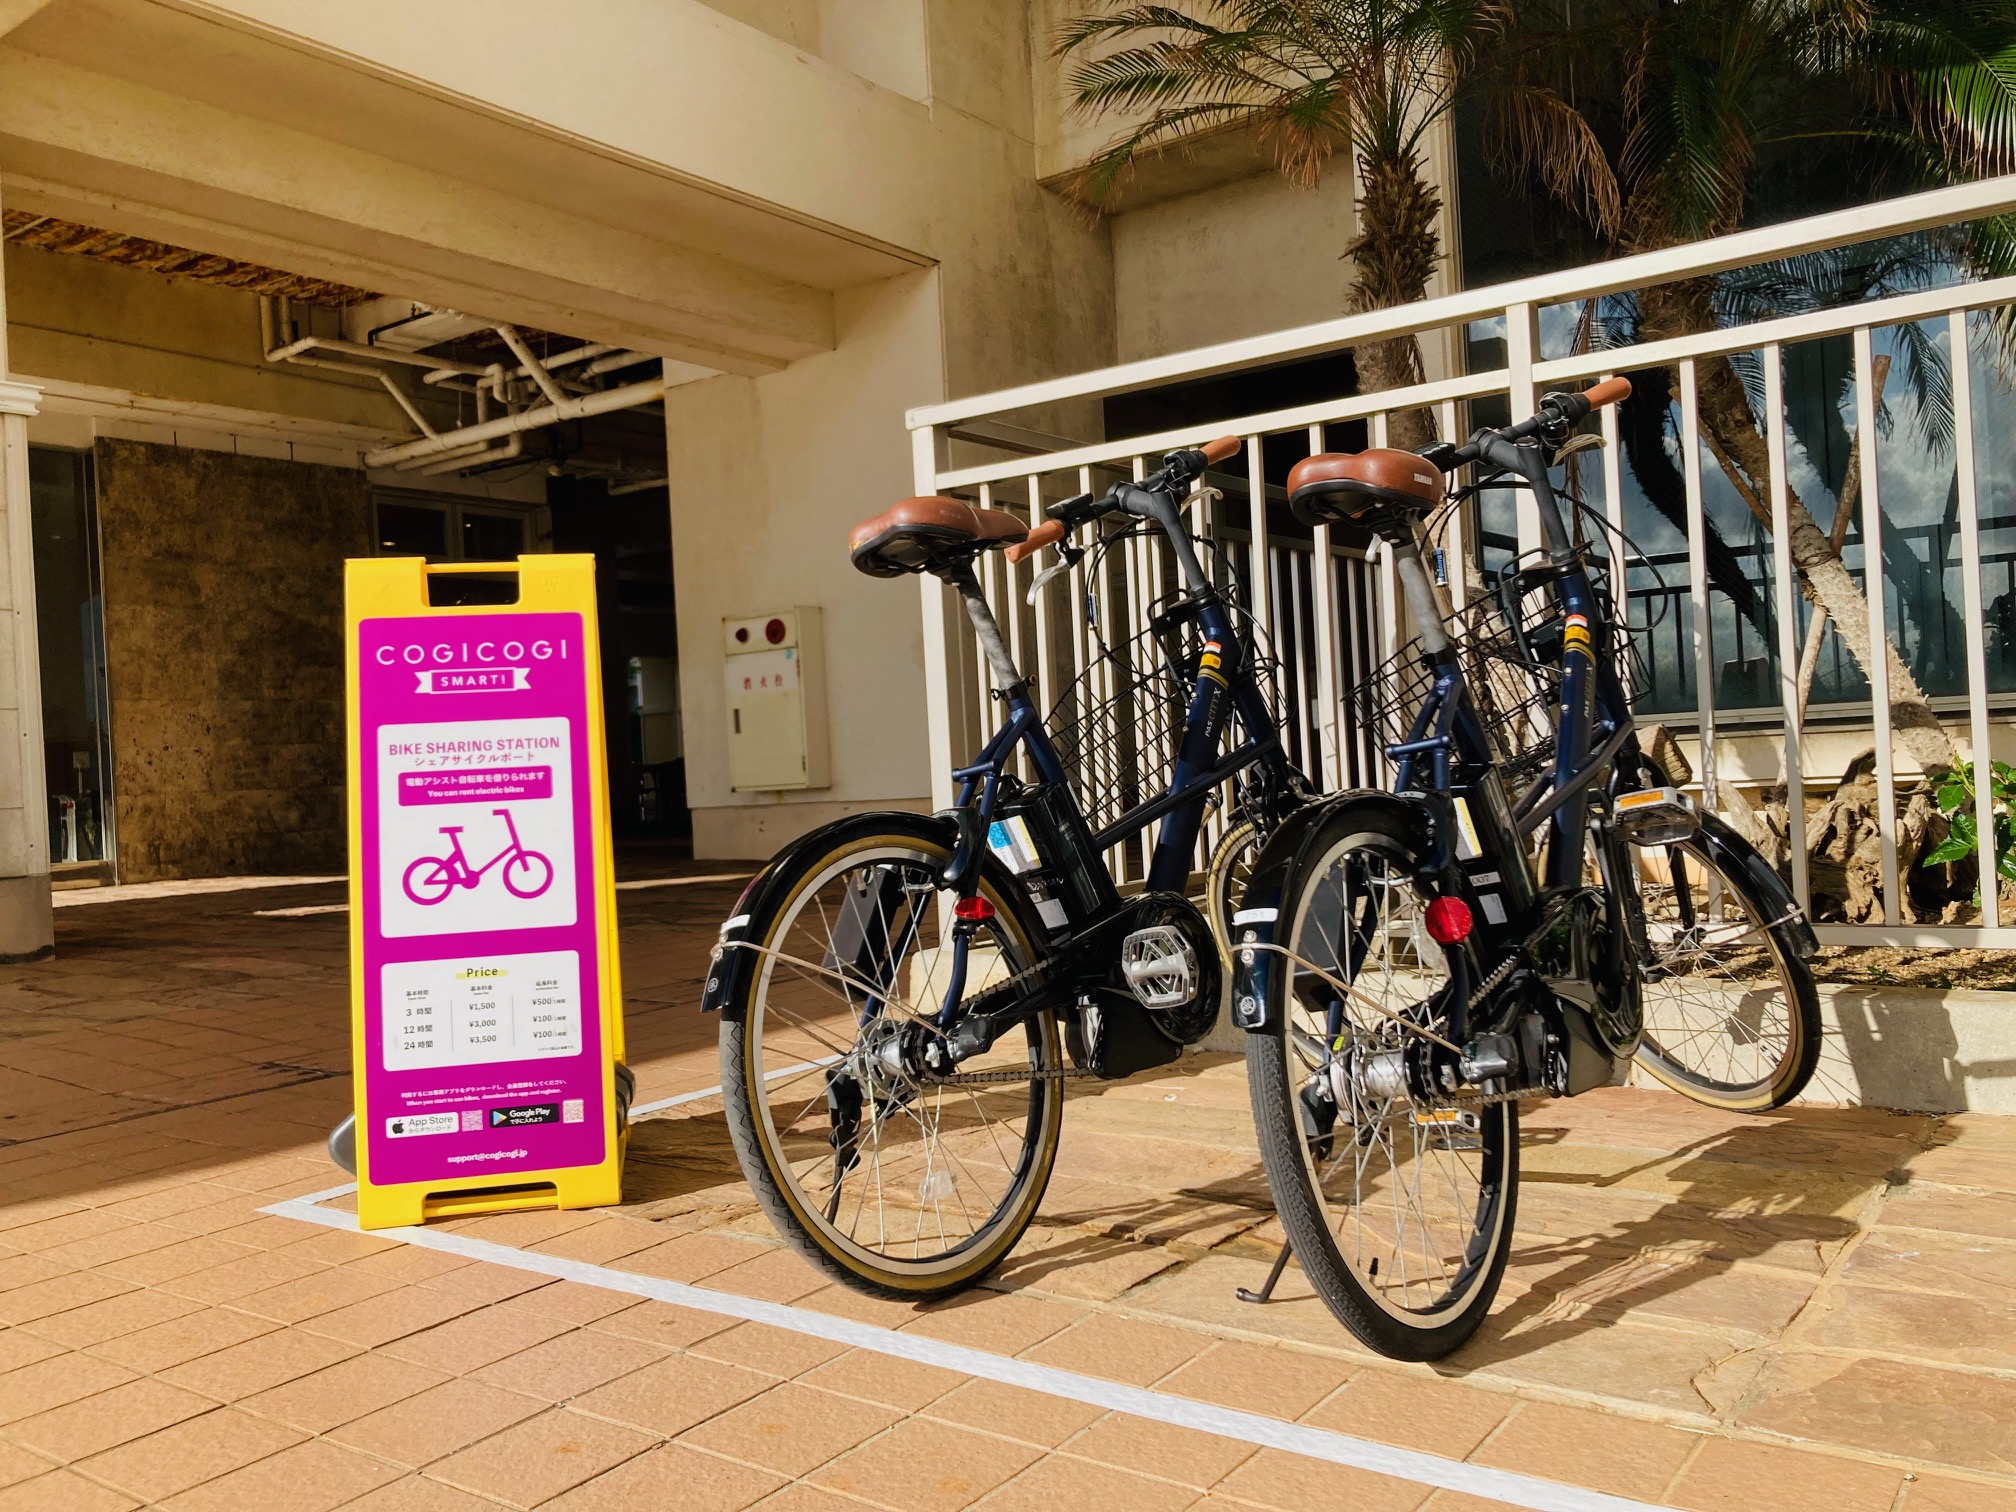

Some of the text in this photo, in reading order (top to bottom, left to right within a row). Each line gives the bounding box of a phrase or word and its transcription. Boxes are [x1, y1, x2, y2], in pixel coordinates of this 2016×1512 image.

[376, 639, 567, 666] COGICOGI
[743, 673, 784, 690] 消火栓
[1204, 720, 1213, 737] PAS
[389, 737, 560, 756] BIKE SHARING STATION
[414, 752, 535, 767] シェアサイクルポート
[427, 790, 443, 798] You
[459, 788, 475, 796] rent
[475, 786, 503, 795] electric
[504, 785, 525, 794] bikes
[466, 966, 499, 978] Price
[469, 1002, 496, 1010] ¥1,500
[406, 1007, 432, 1017] 3 時間
[403, 1024, 433, 1034] 12 時間
[469, 1019, 497, 1028] ¥3,000
[404, 1040, 434, 1050] 24 時間
[469, 1035, 497, 1044] ¥3,500
[481, 1092, 508, 1100] download
[509, 1107, 550, 1118] Google Play
[408, 1116, 453, 1127] App Store
[408, 1125, 452, 1134] からダウンロード
[447, 1148, 528, 1163] support@cogicogi.jp
